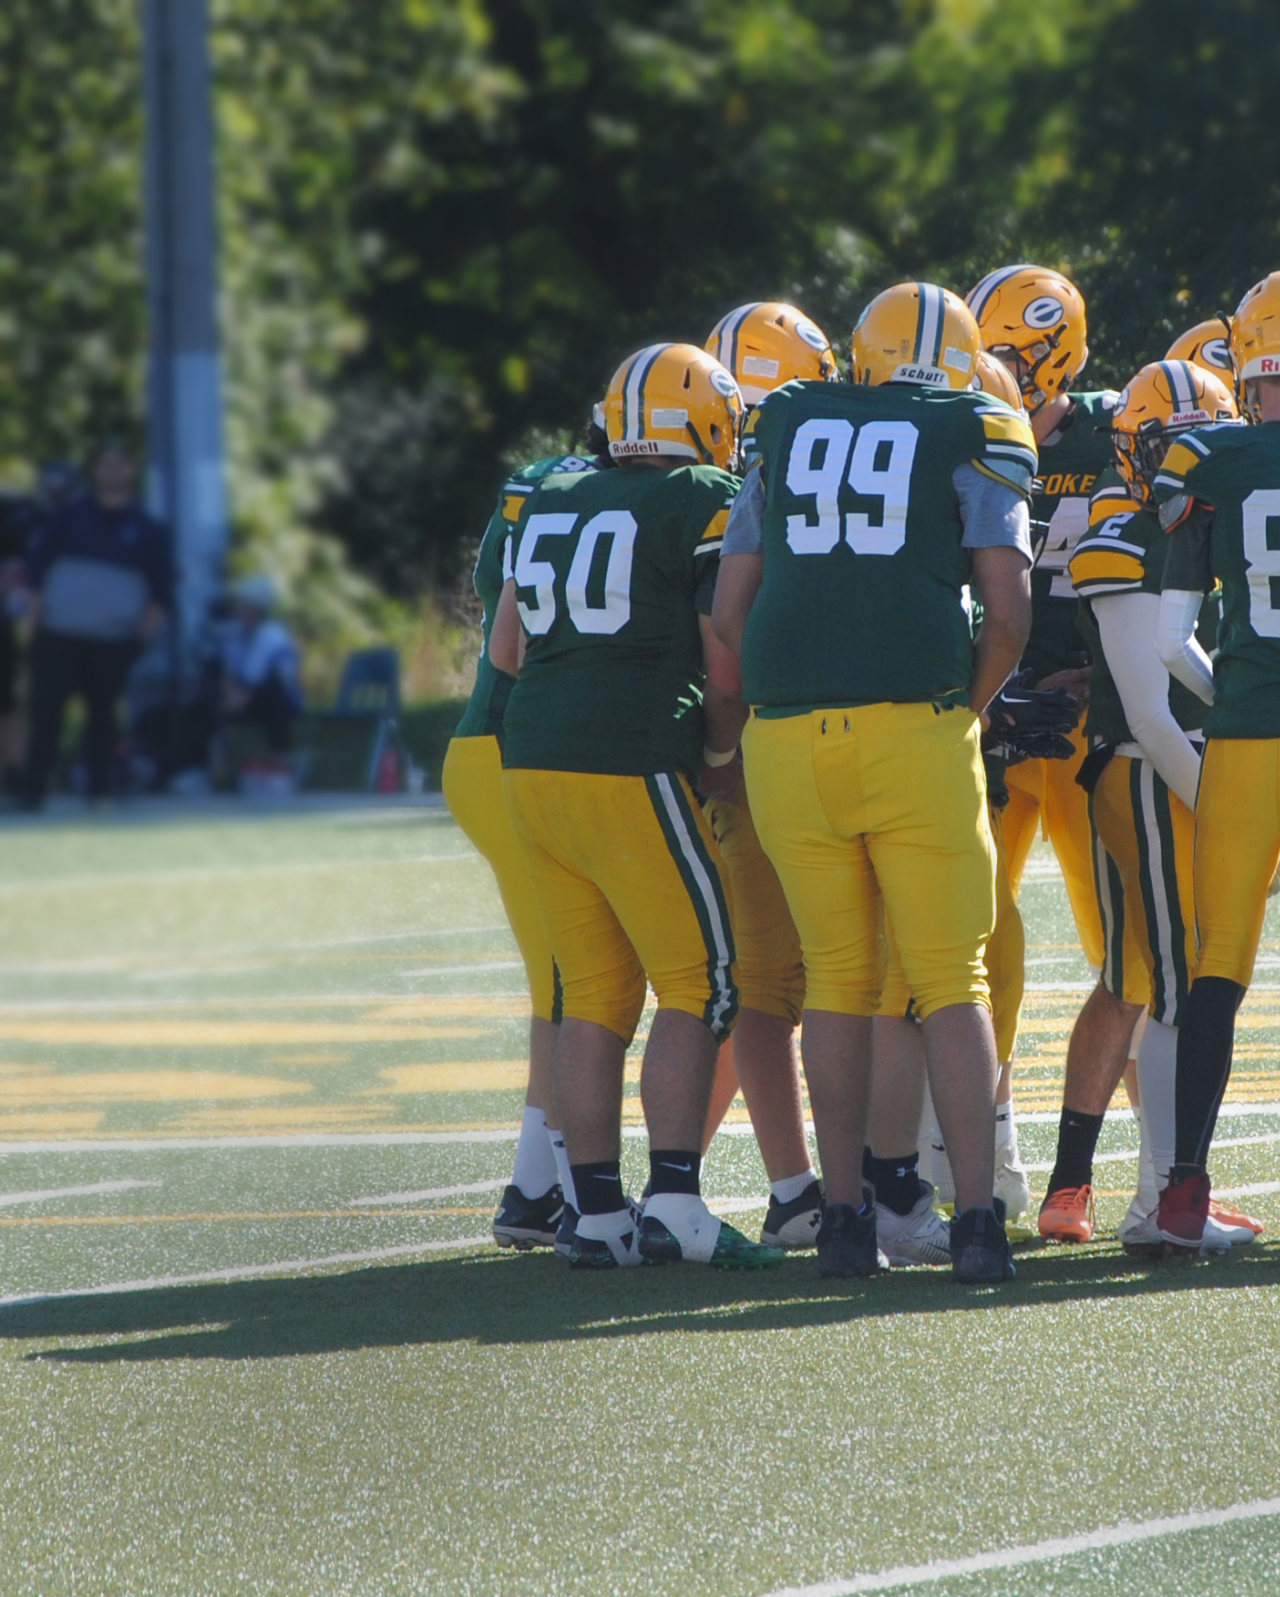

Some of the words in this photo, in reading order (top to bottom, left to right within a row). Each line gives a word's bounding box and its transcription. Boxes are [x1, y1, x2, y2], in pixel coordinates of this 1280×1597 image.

[899, 367, 946, 383] schutt
[1172, 410, 1207, 423] Riddell
[612, 442, 659, 455] Riddell
[785, 418, 920, 556] 99
[1035, 473, 1097, 496] OKE
[1097, 511, 1136, 538] 2
[514, 509, 639, 636] 50
